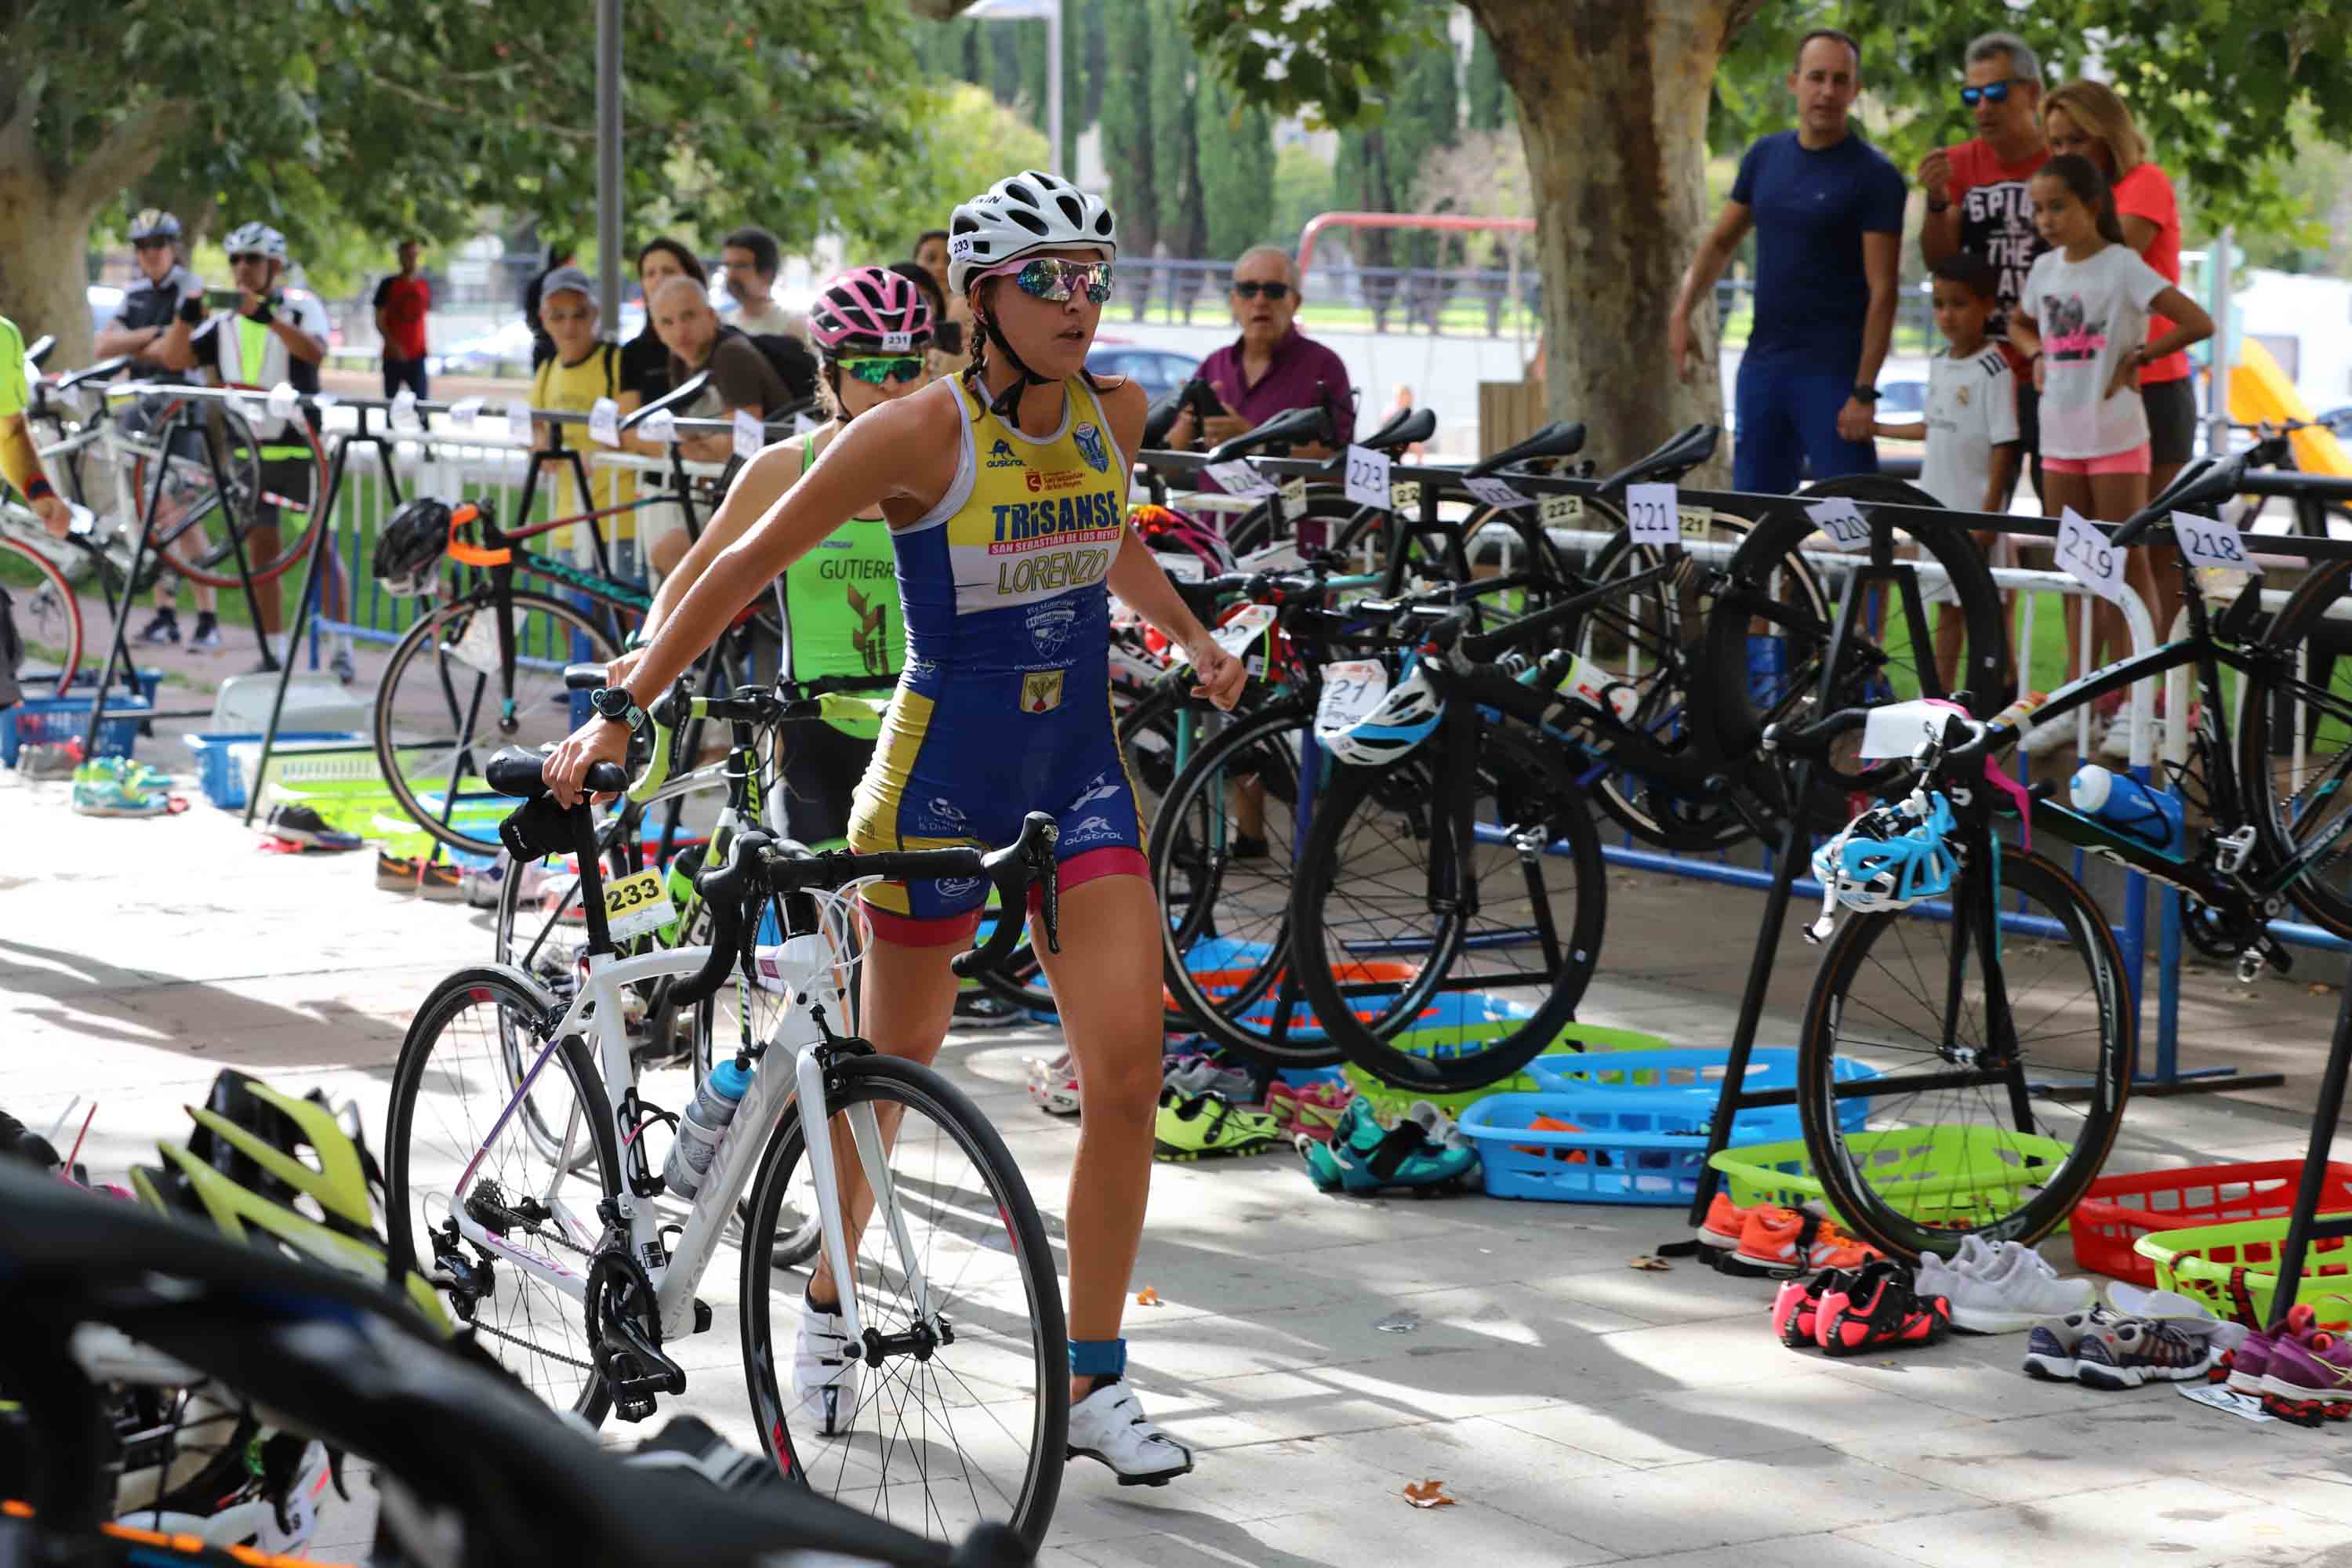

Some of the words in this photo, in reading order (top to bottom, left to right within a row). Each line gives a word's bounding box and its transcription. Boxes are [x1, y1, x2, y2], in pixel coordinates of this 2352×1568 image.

[953, 239, 969, 254] 233
[1987, 238, 2033, 267] THE
[887, 336, 908, 344] 231
[1350, 459, 1382, 493] 223
[1548, 499, 1577, 518] 222
[1633, 502, 1670, 531] 221
[991, 543, 1014, 554] SAN
[1079, 531, 1095, 541] LOS
[1823, 515, 1870, 541] 220
[2063, 526, 2113, 579] 219
[2186, 528, 2244, 562] 218
[997, 548, 1109, 595] LORENZO
[1064, 831, 1123, 847] austral
[605, 877, 659, 913] 233
